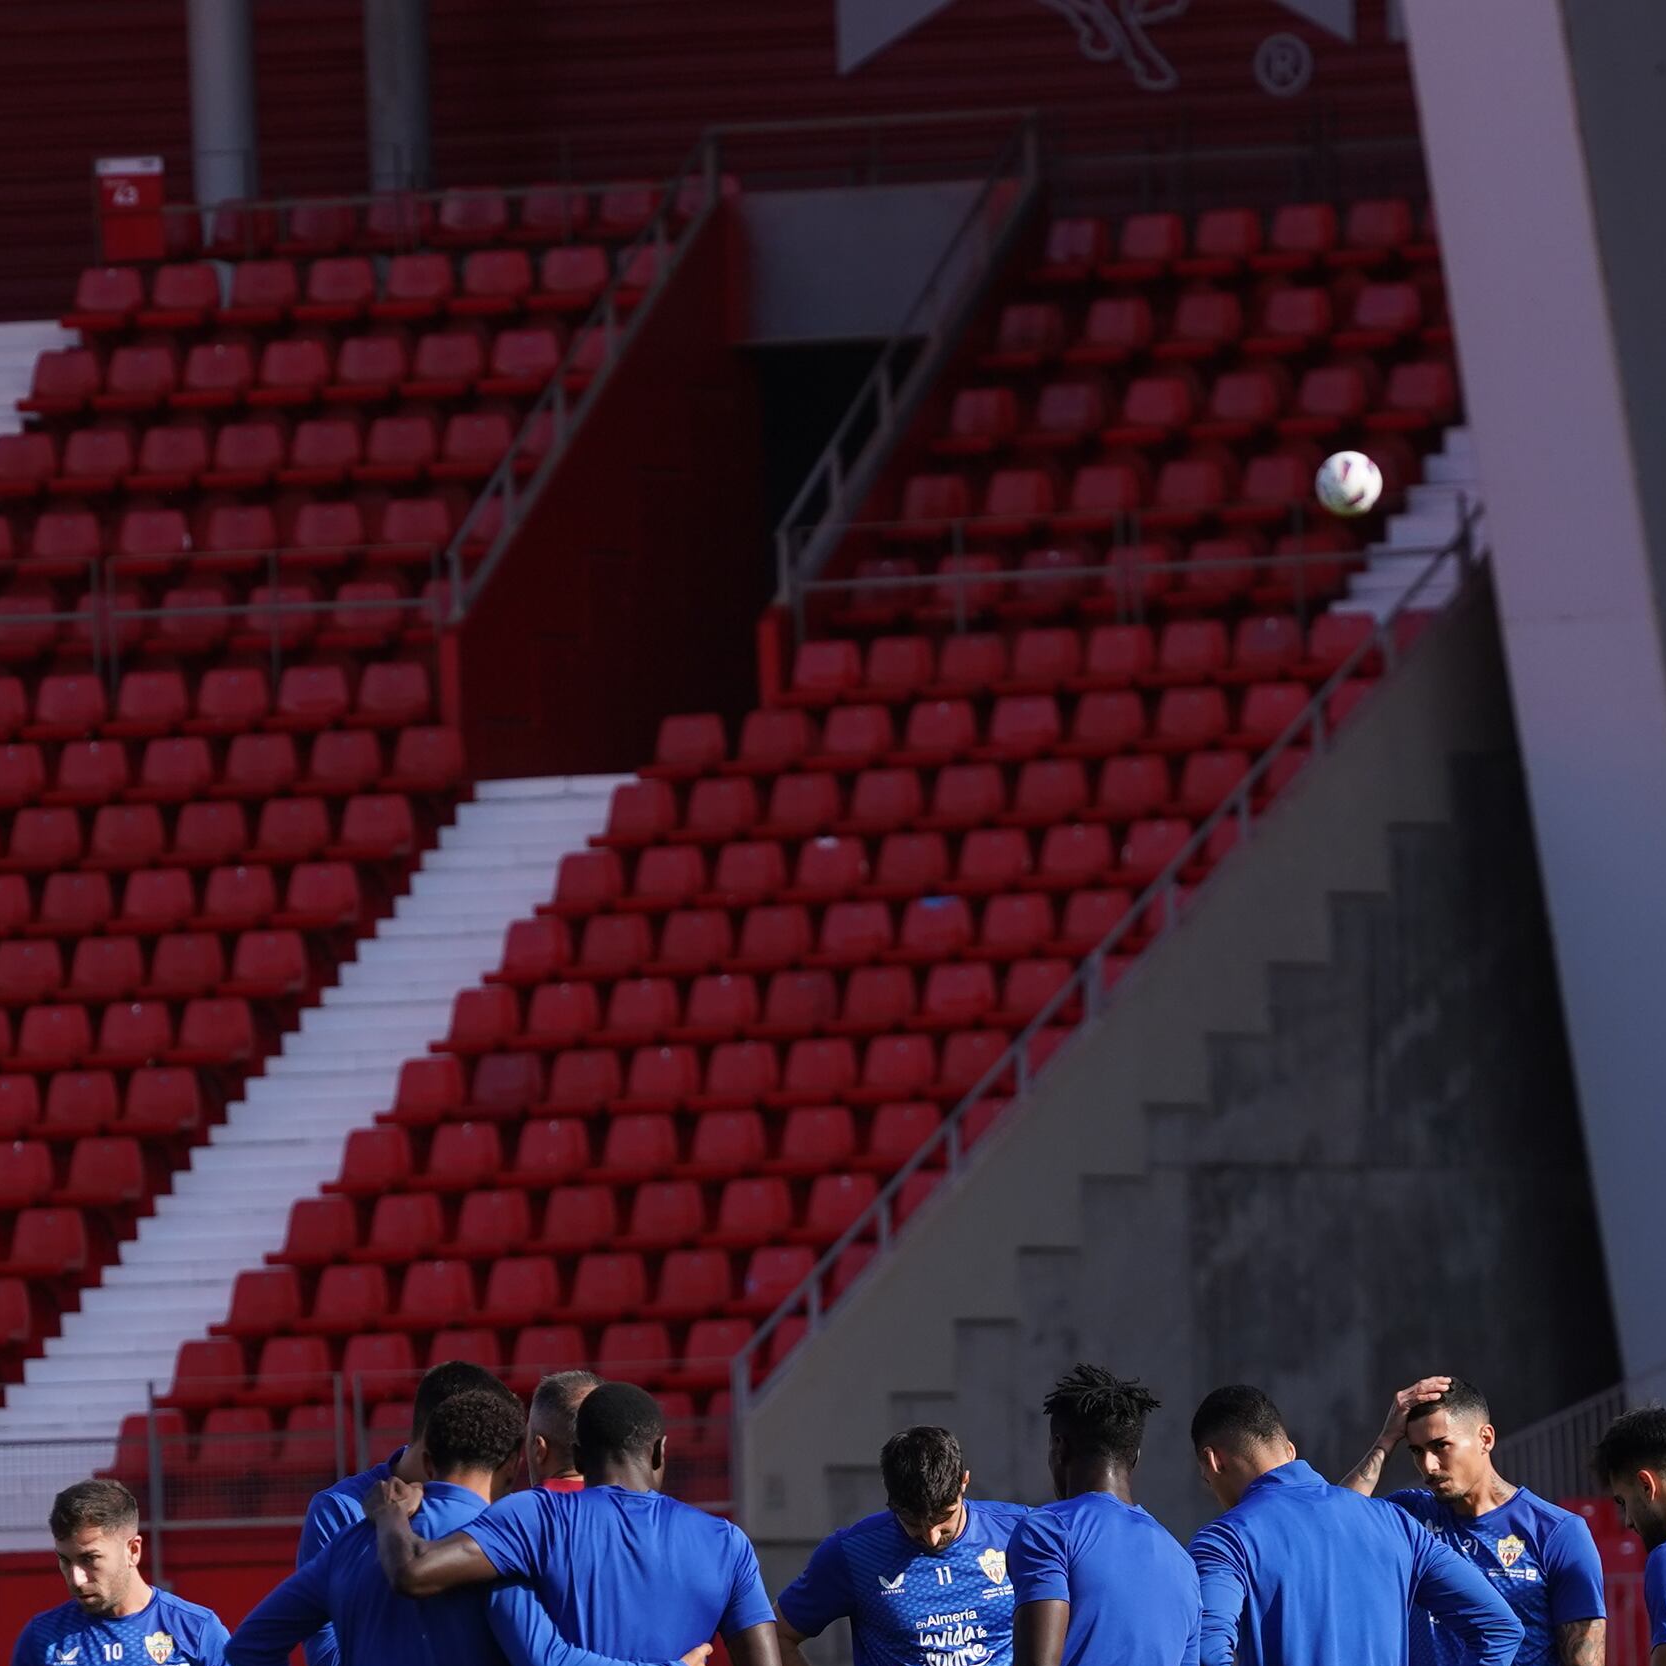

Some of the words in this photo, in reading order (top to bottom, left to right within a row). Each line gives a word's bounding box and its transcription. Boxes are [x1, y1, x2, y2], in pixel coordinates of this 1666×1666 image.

[935, 1566, 953, 1585] 11
[920, 1632, 933, 1646] la
[933, 1623, 975, 1647] vida
[976, 1626, 988, 1638] te
[103, 1643, 123, 1661] 10
